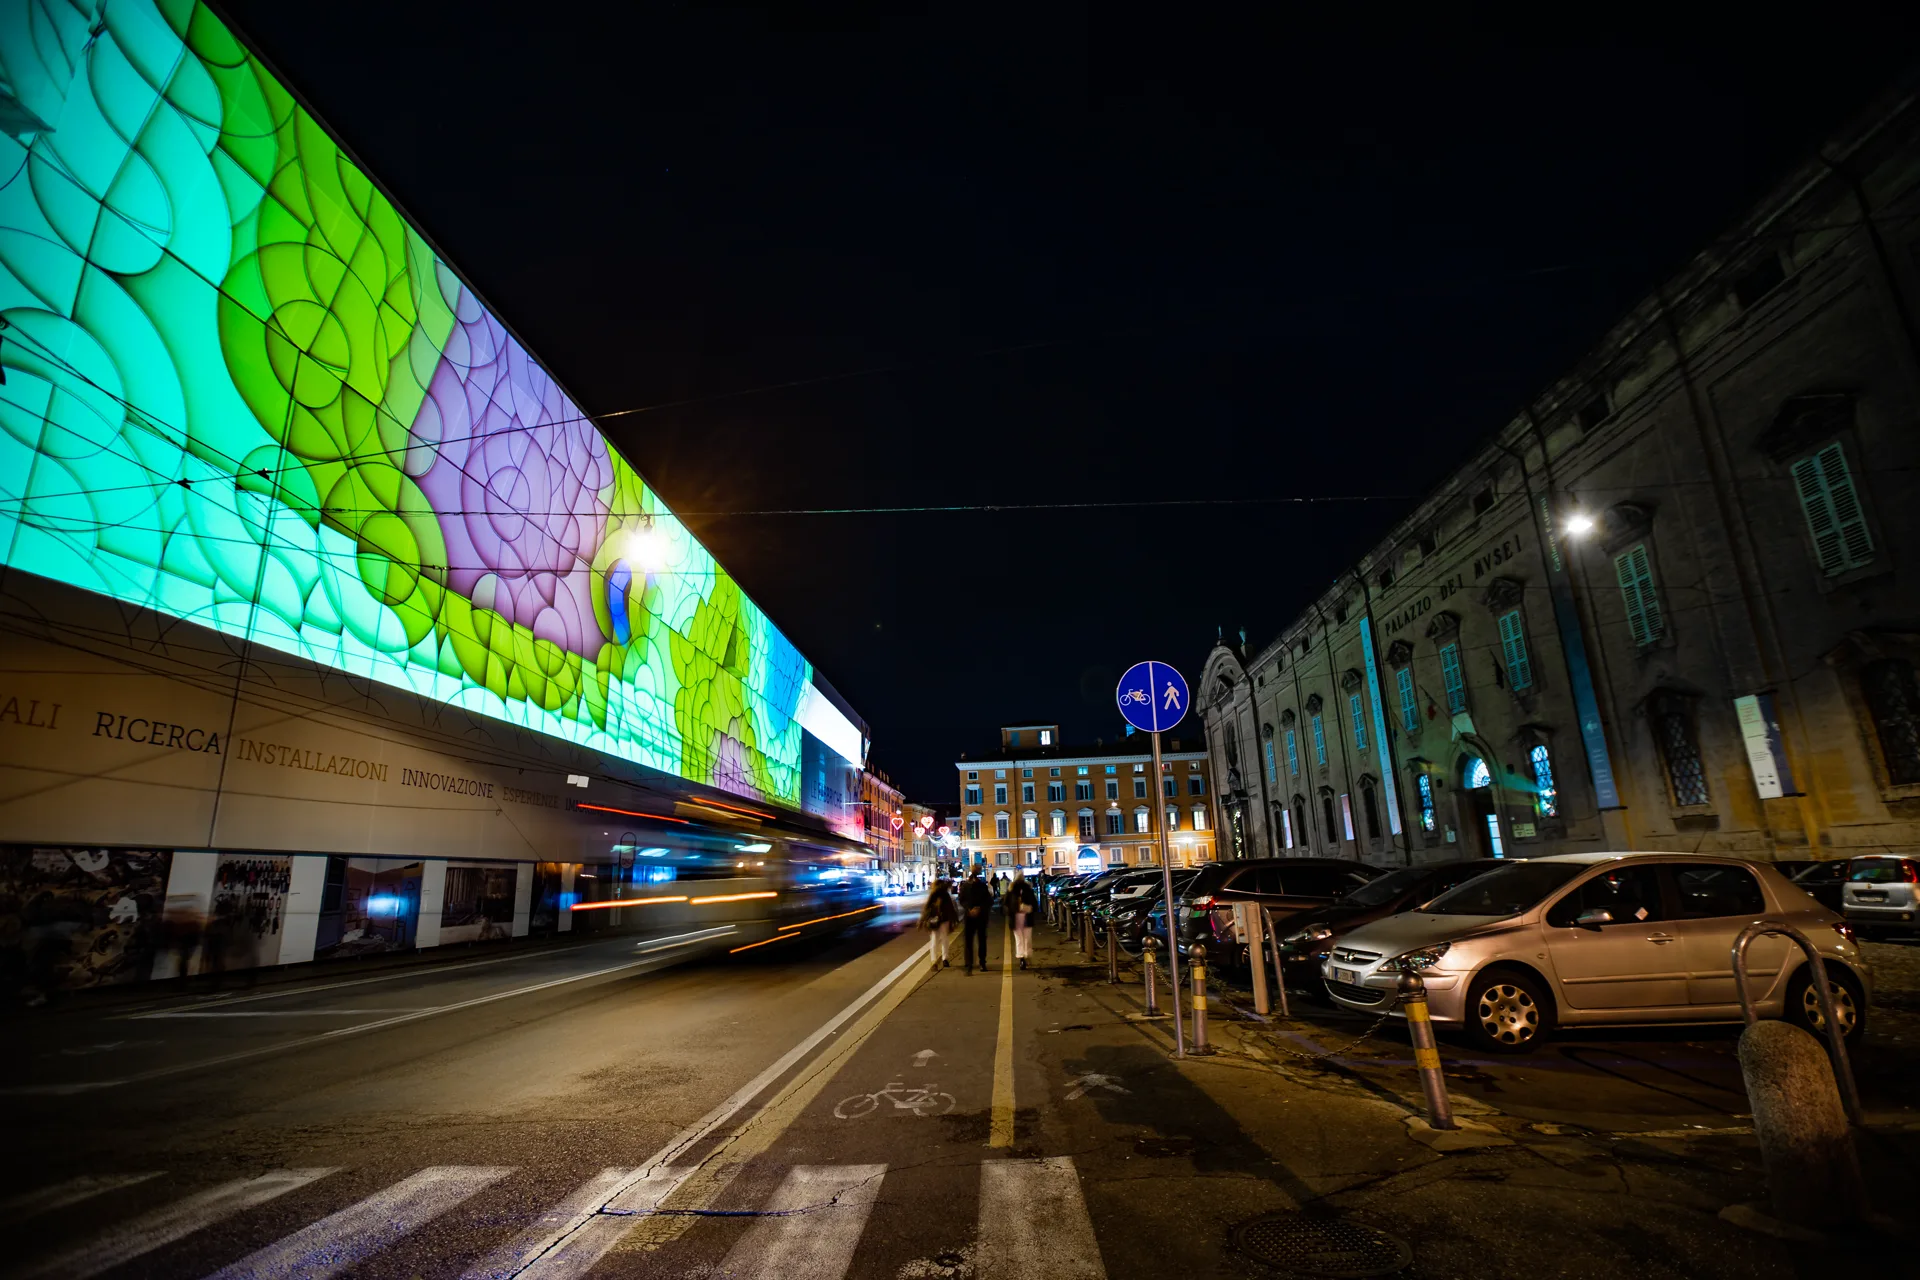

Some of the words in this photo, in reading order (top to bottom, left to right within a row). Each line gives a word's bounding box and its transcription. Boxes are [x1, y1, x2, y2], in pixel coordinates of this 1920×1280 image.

[1385, 596, 1432, 637] PALAZZO
[1440, 573, 1463, 601] DEI
[1474, 534, 1522, 579] MVSEI
[0, 694, 62, 730] ALI
[92, 711, 221, 755] RICERCA
[237, 738, 388, 782] INSTALLAZIONI
[401, 768, 495, 799] INNOVAZIONE
[502, 786, 559, 809] ESPERIENZE
